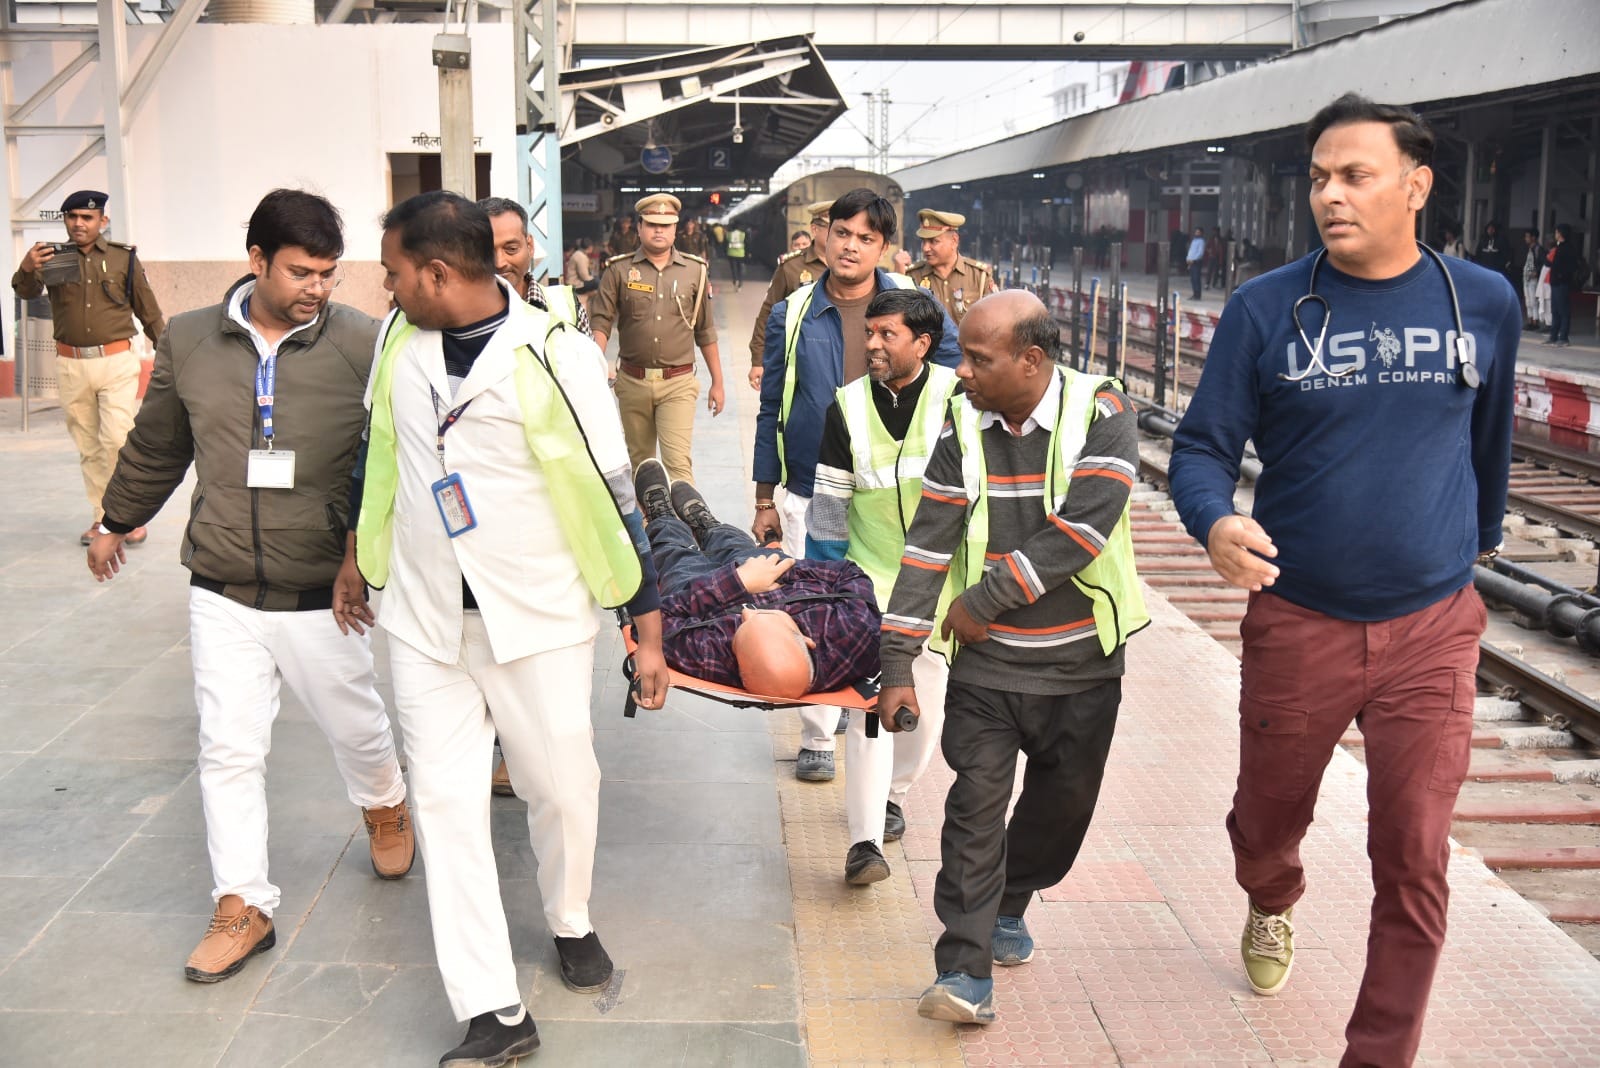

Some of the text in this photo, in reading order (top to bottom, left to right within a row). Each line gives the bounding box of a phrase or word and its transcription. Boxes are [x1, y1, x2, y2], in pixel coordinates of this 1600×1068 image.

[713, 150, 726, 167] 2
[1300, 371, 1456, 391] DENIM COMPAN
